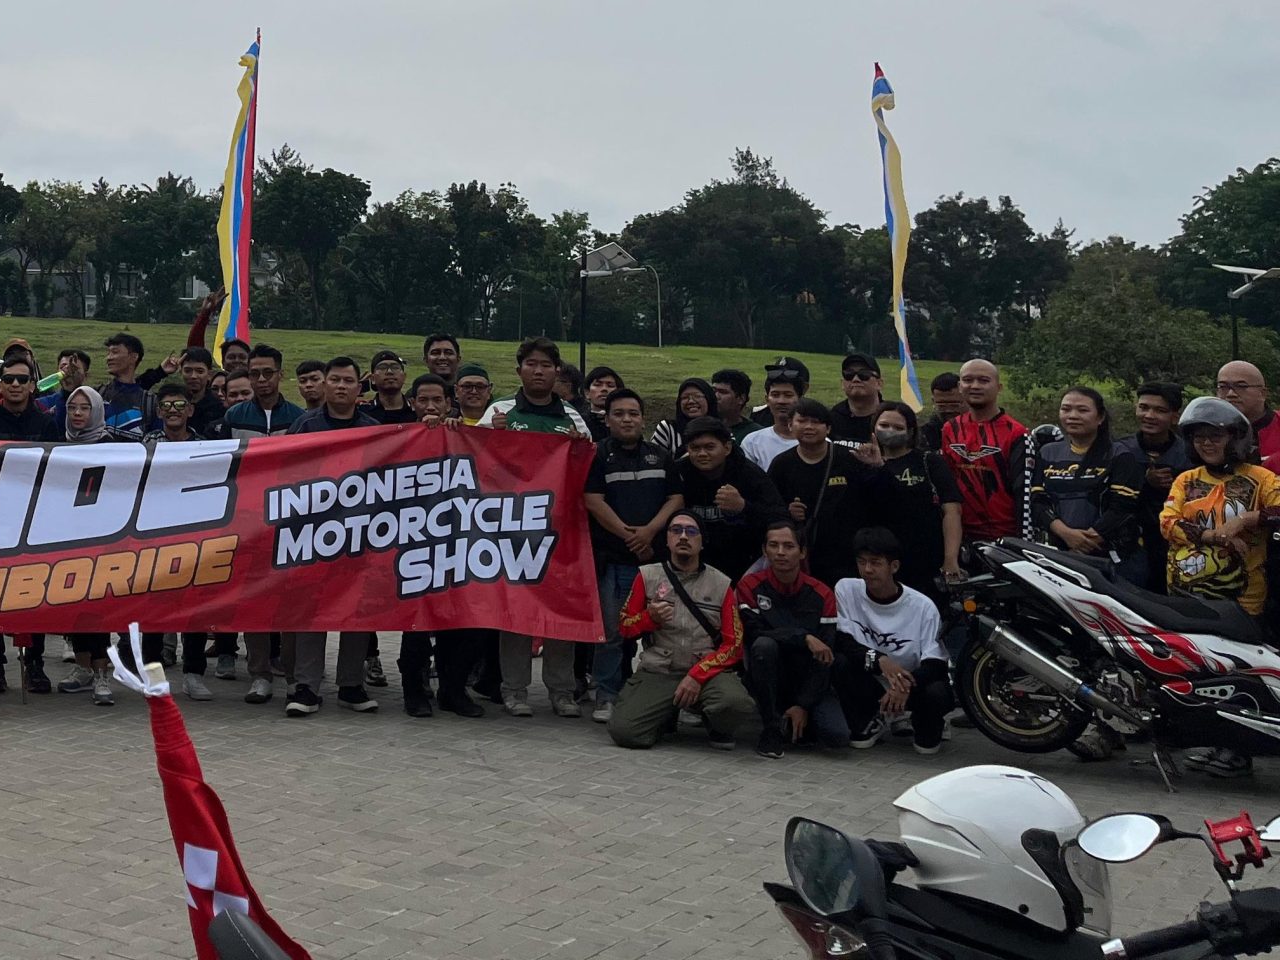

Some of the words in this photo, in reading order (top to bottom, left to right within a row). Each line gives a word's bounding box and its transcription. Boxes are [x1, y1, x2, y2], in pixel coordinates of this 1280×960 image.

[267, 457, 476, 522] INDONESIA
[275, 493, 553, 567] MOTORCYCLE
[398, 535, 555, 596] SHOW
